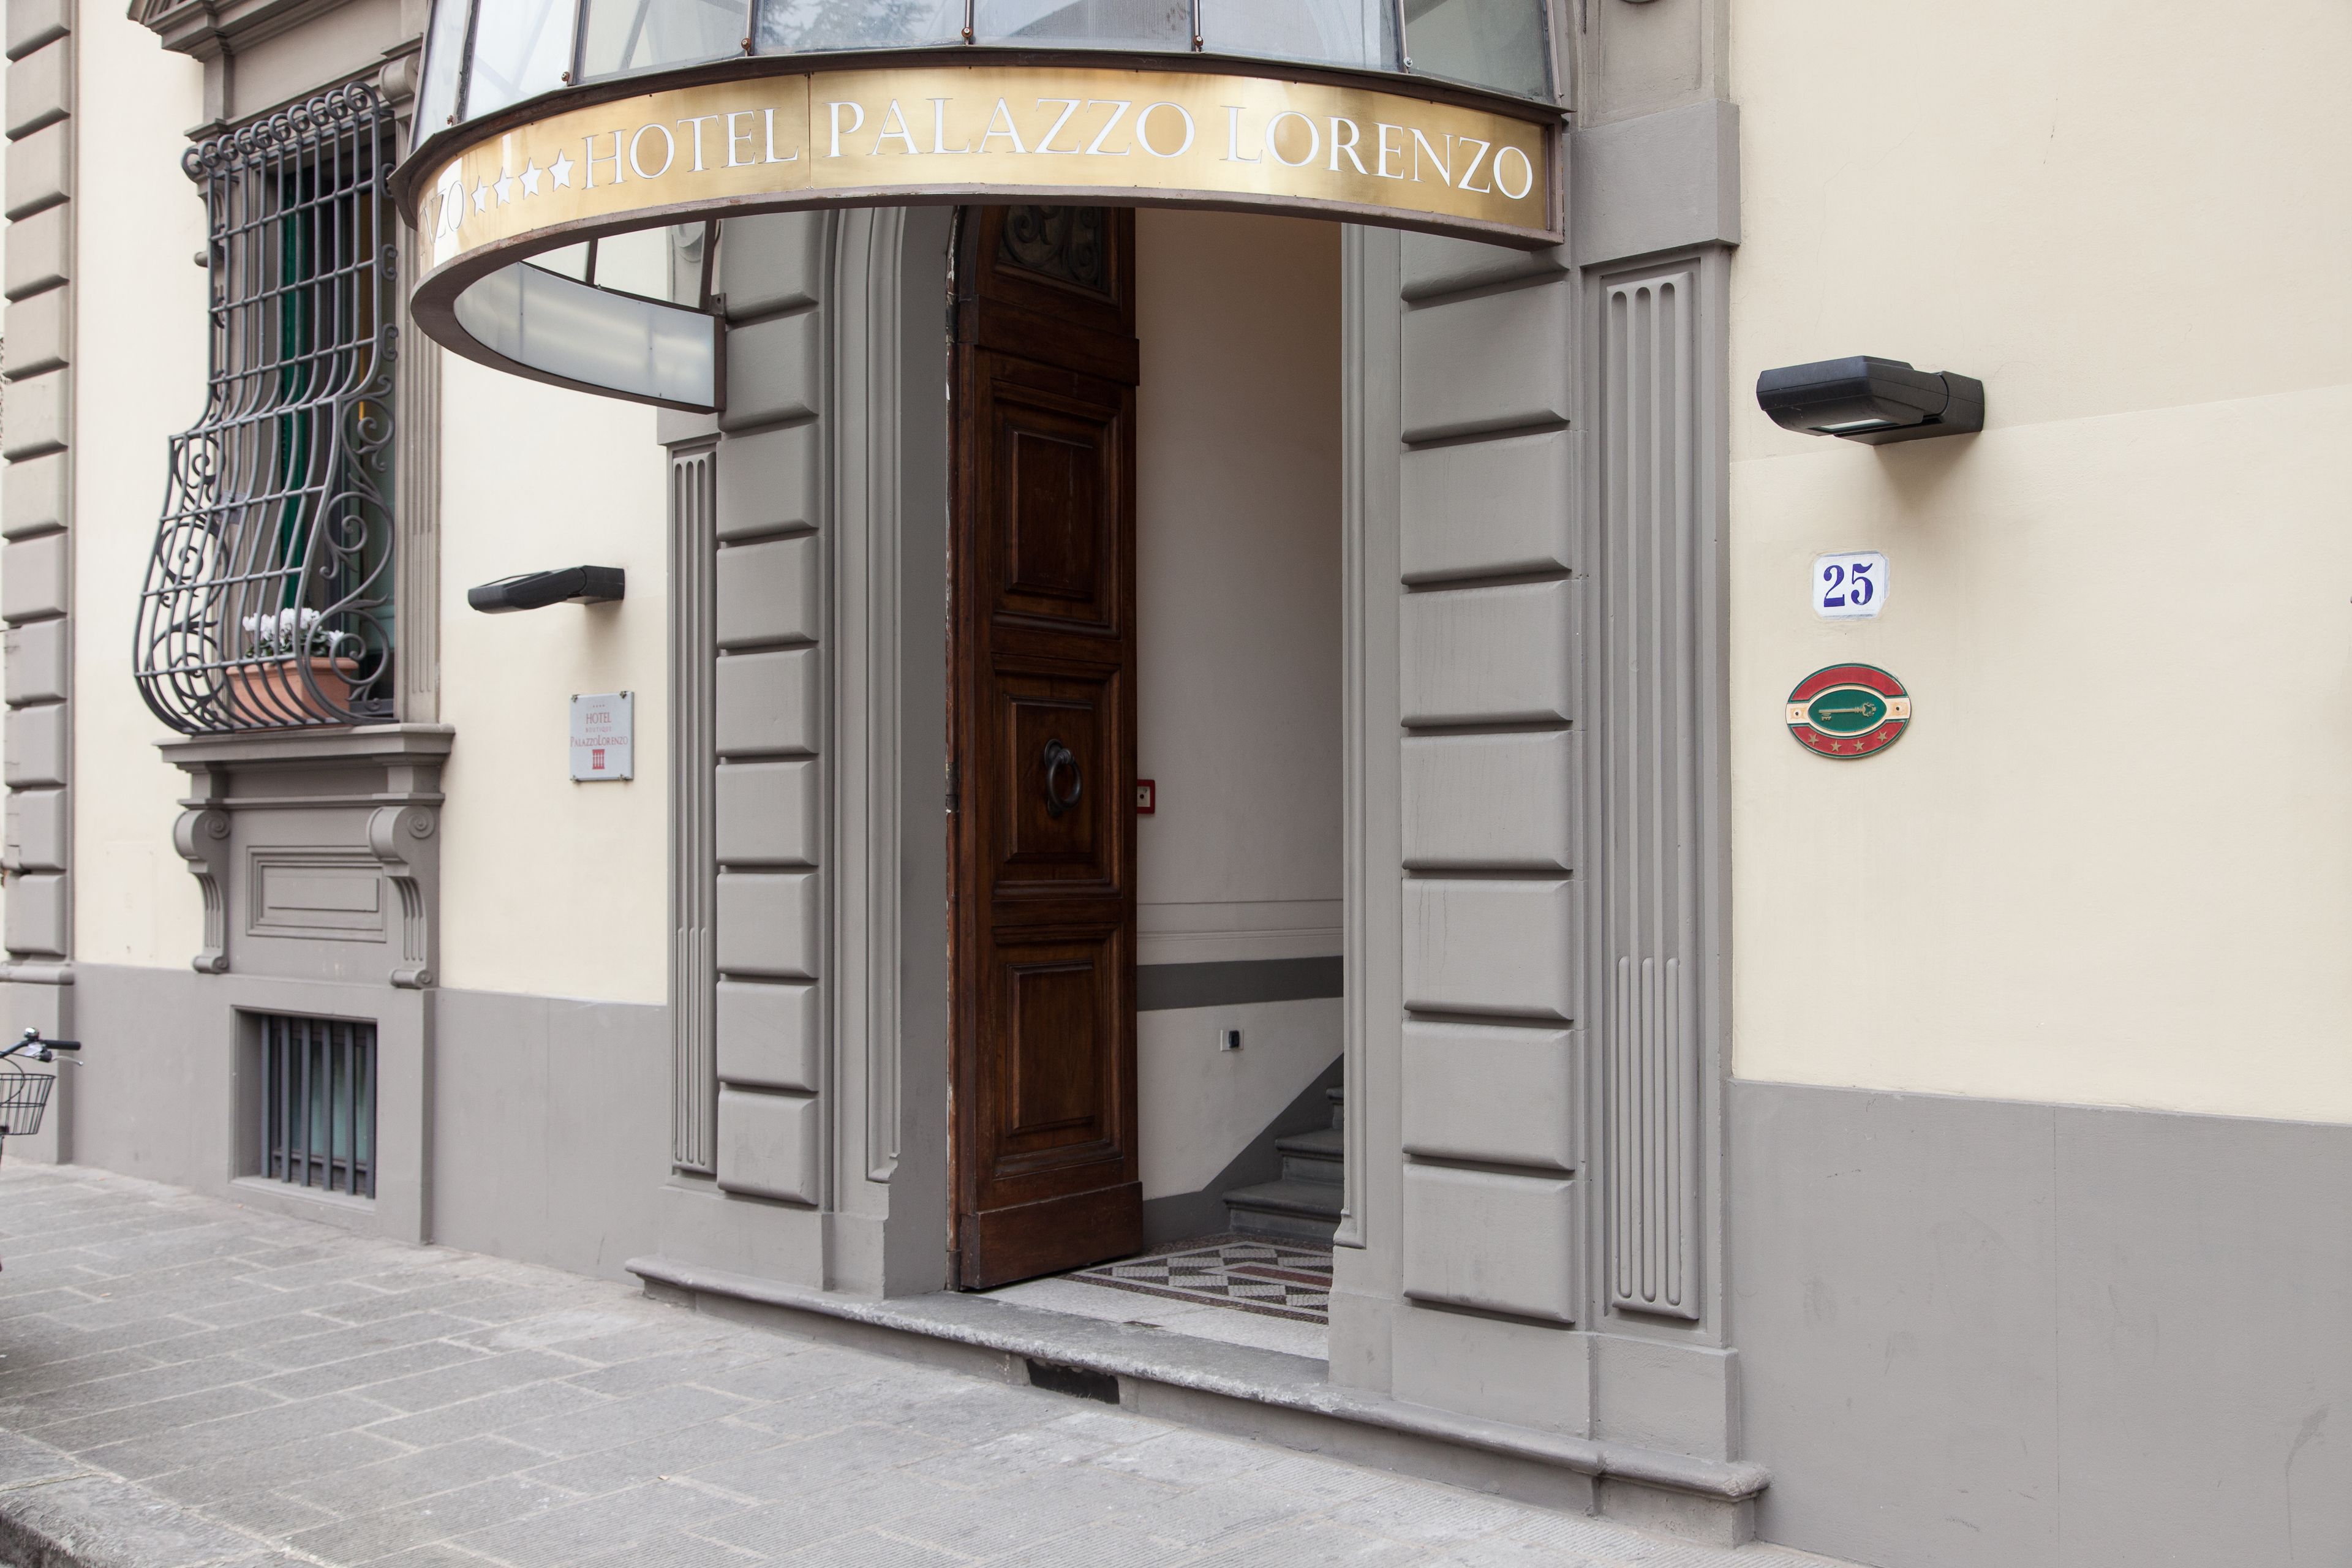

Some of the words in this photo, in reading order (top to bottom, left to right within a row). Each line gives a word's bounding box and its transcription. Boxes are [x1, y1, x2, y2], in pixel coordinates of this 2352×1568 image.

[581, 107, 799, 190] HOTEL
[821, 97, 1196, 159] PALAZZO
[1219, 106, 1533, 200] LORENZO
[1823, 563, 1874, 608] 25
[586, 712, 612, 725] HOTEL
